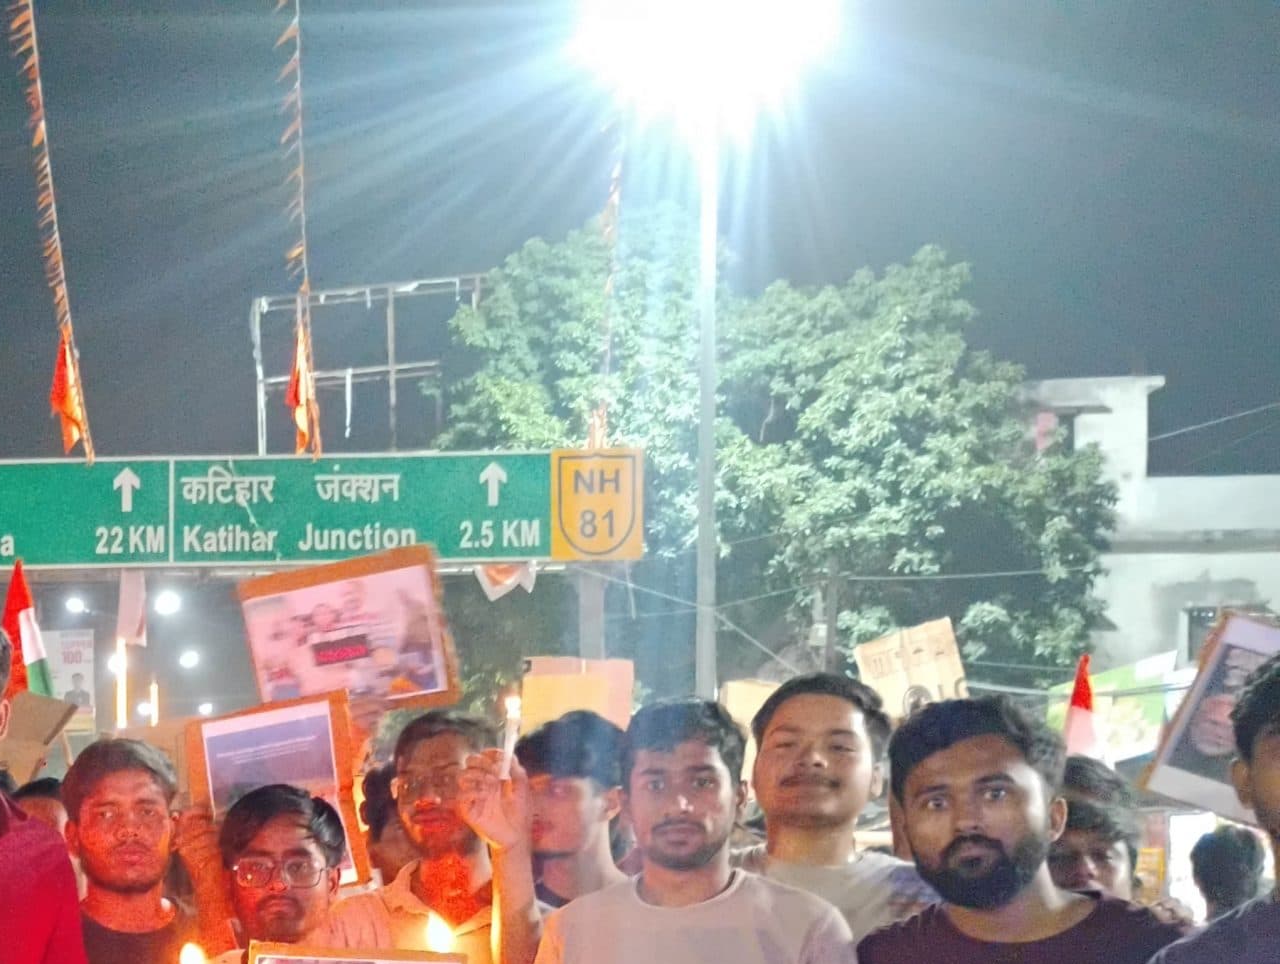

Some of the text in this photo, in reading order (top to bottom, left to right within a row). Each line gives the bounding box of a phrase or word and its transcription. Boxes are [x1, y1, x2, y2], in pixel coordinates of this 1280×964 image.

[180, 465, 276, 504] कटिहार
[573, 469, 620, 495] NH
[95, 525, 124, 554] 22
[128, 524, 166, 553] KM
[183, 518, 541, 553] Katihar Junction 2.5 KM
[579, 508, 616, 539] 81
